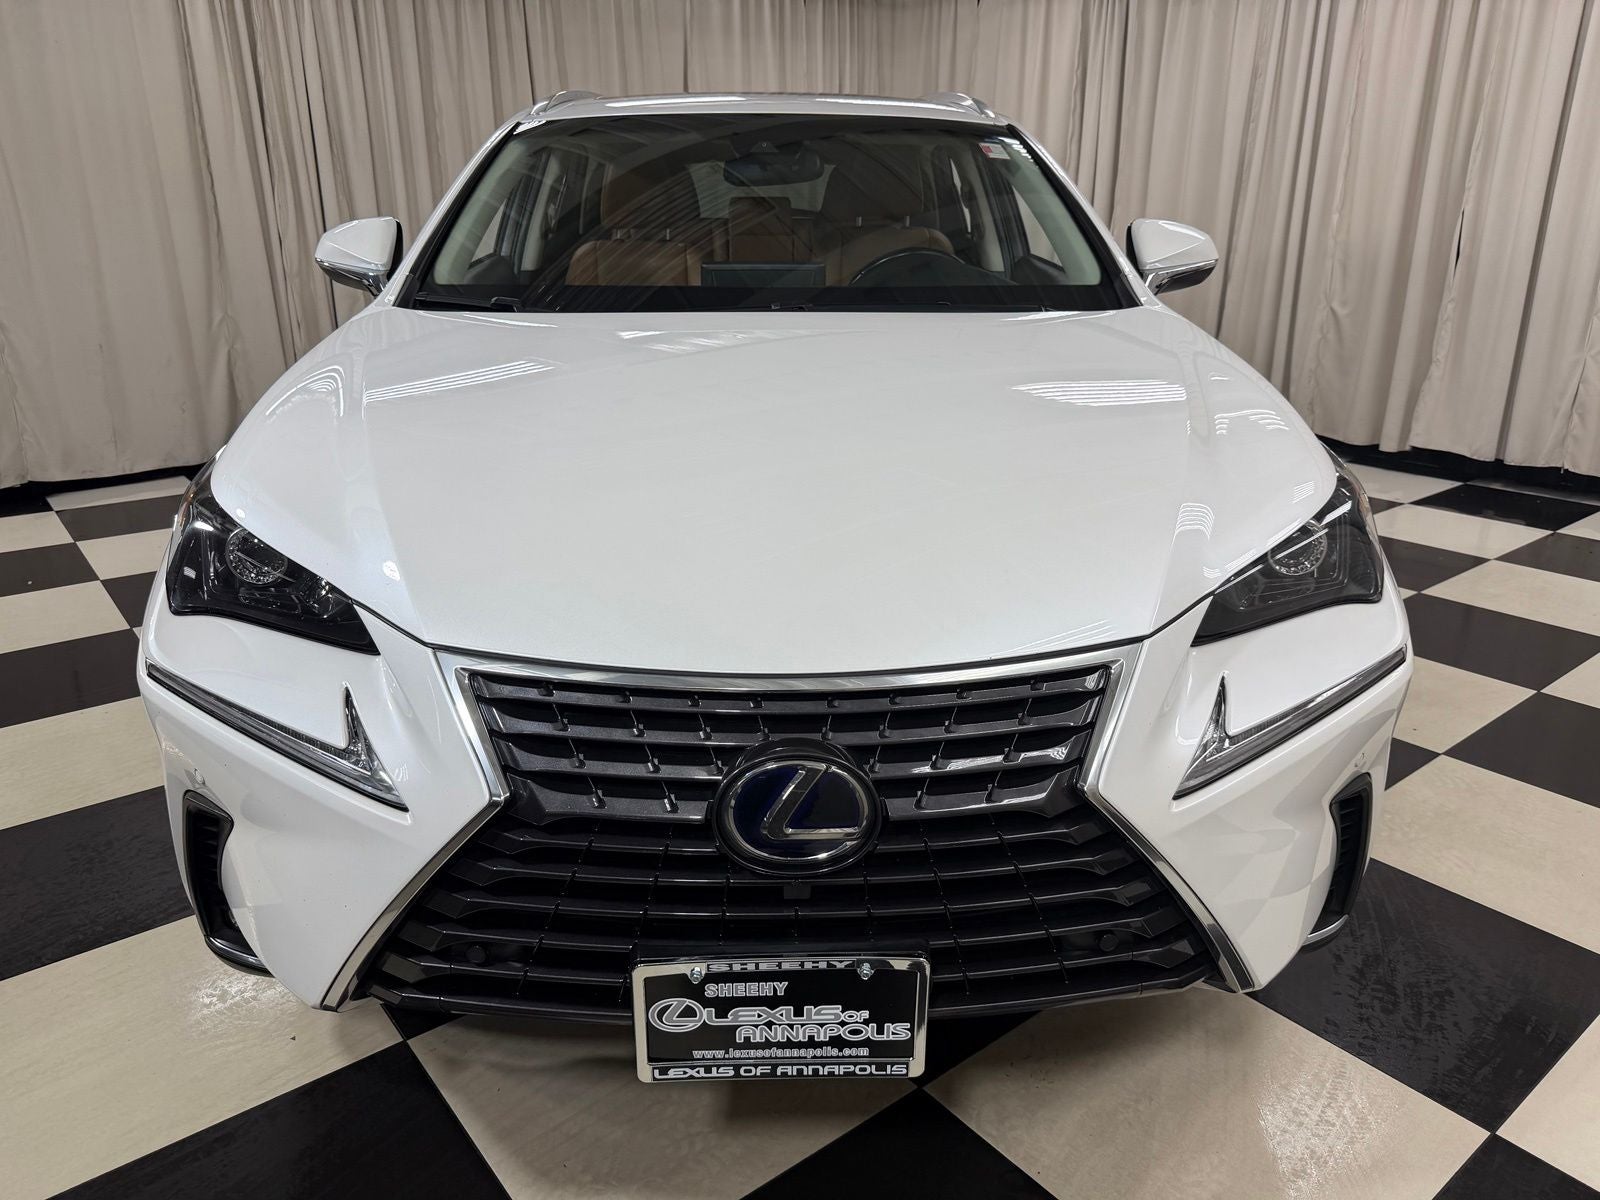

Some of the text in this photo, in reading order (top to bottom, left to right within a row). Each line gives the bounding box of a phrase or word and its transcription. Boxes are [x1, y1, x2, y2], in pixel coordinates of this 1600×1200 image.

[708, 961, 852, 970] SHEEHY
[704, 981, 788, 997] SHEEHY
[705, 1005, 842, 1025] LEXUS
[736, 1023, 911, 1042] ANNAPOLIS
[692, 1046, 869, 1059] www.lexusofannapolis.com
[653, 1064, 907, 1078] LEXUS OF ANNAPOLIS
